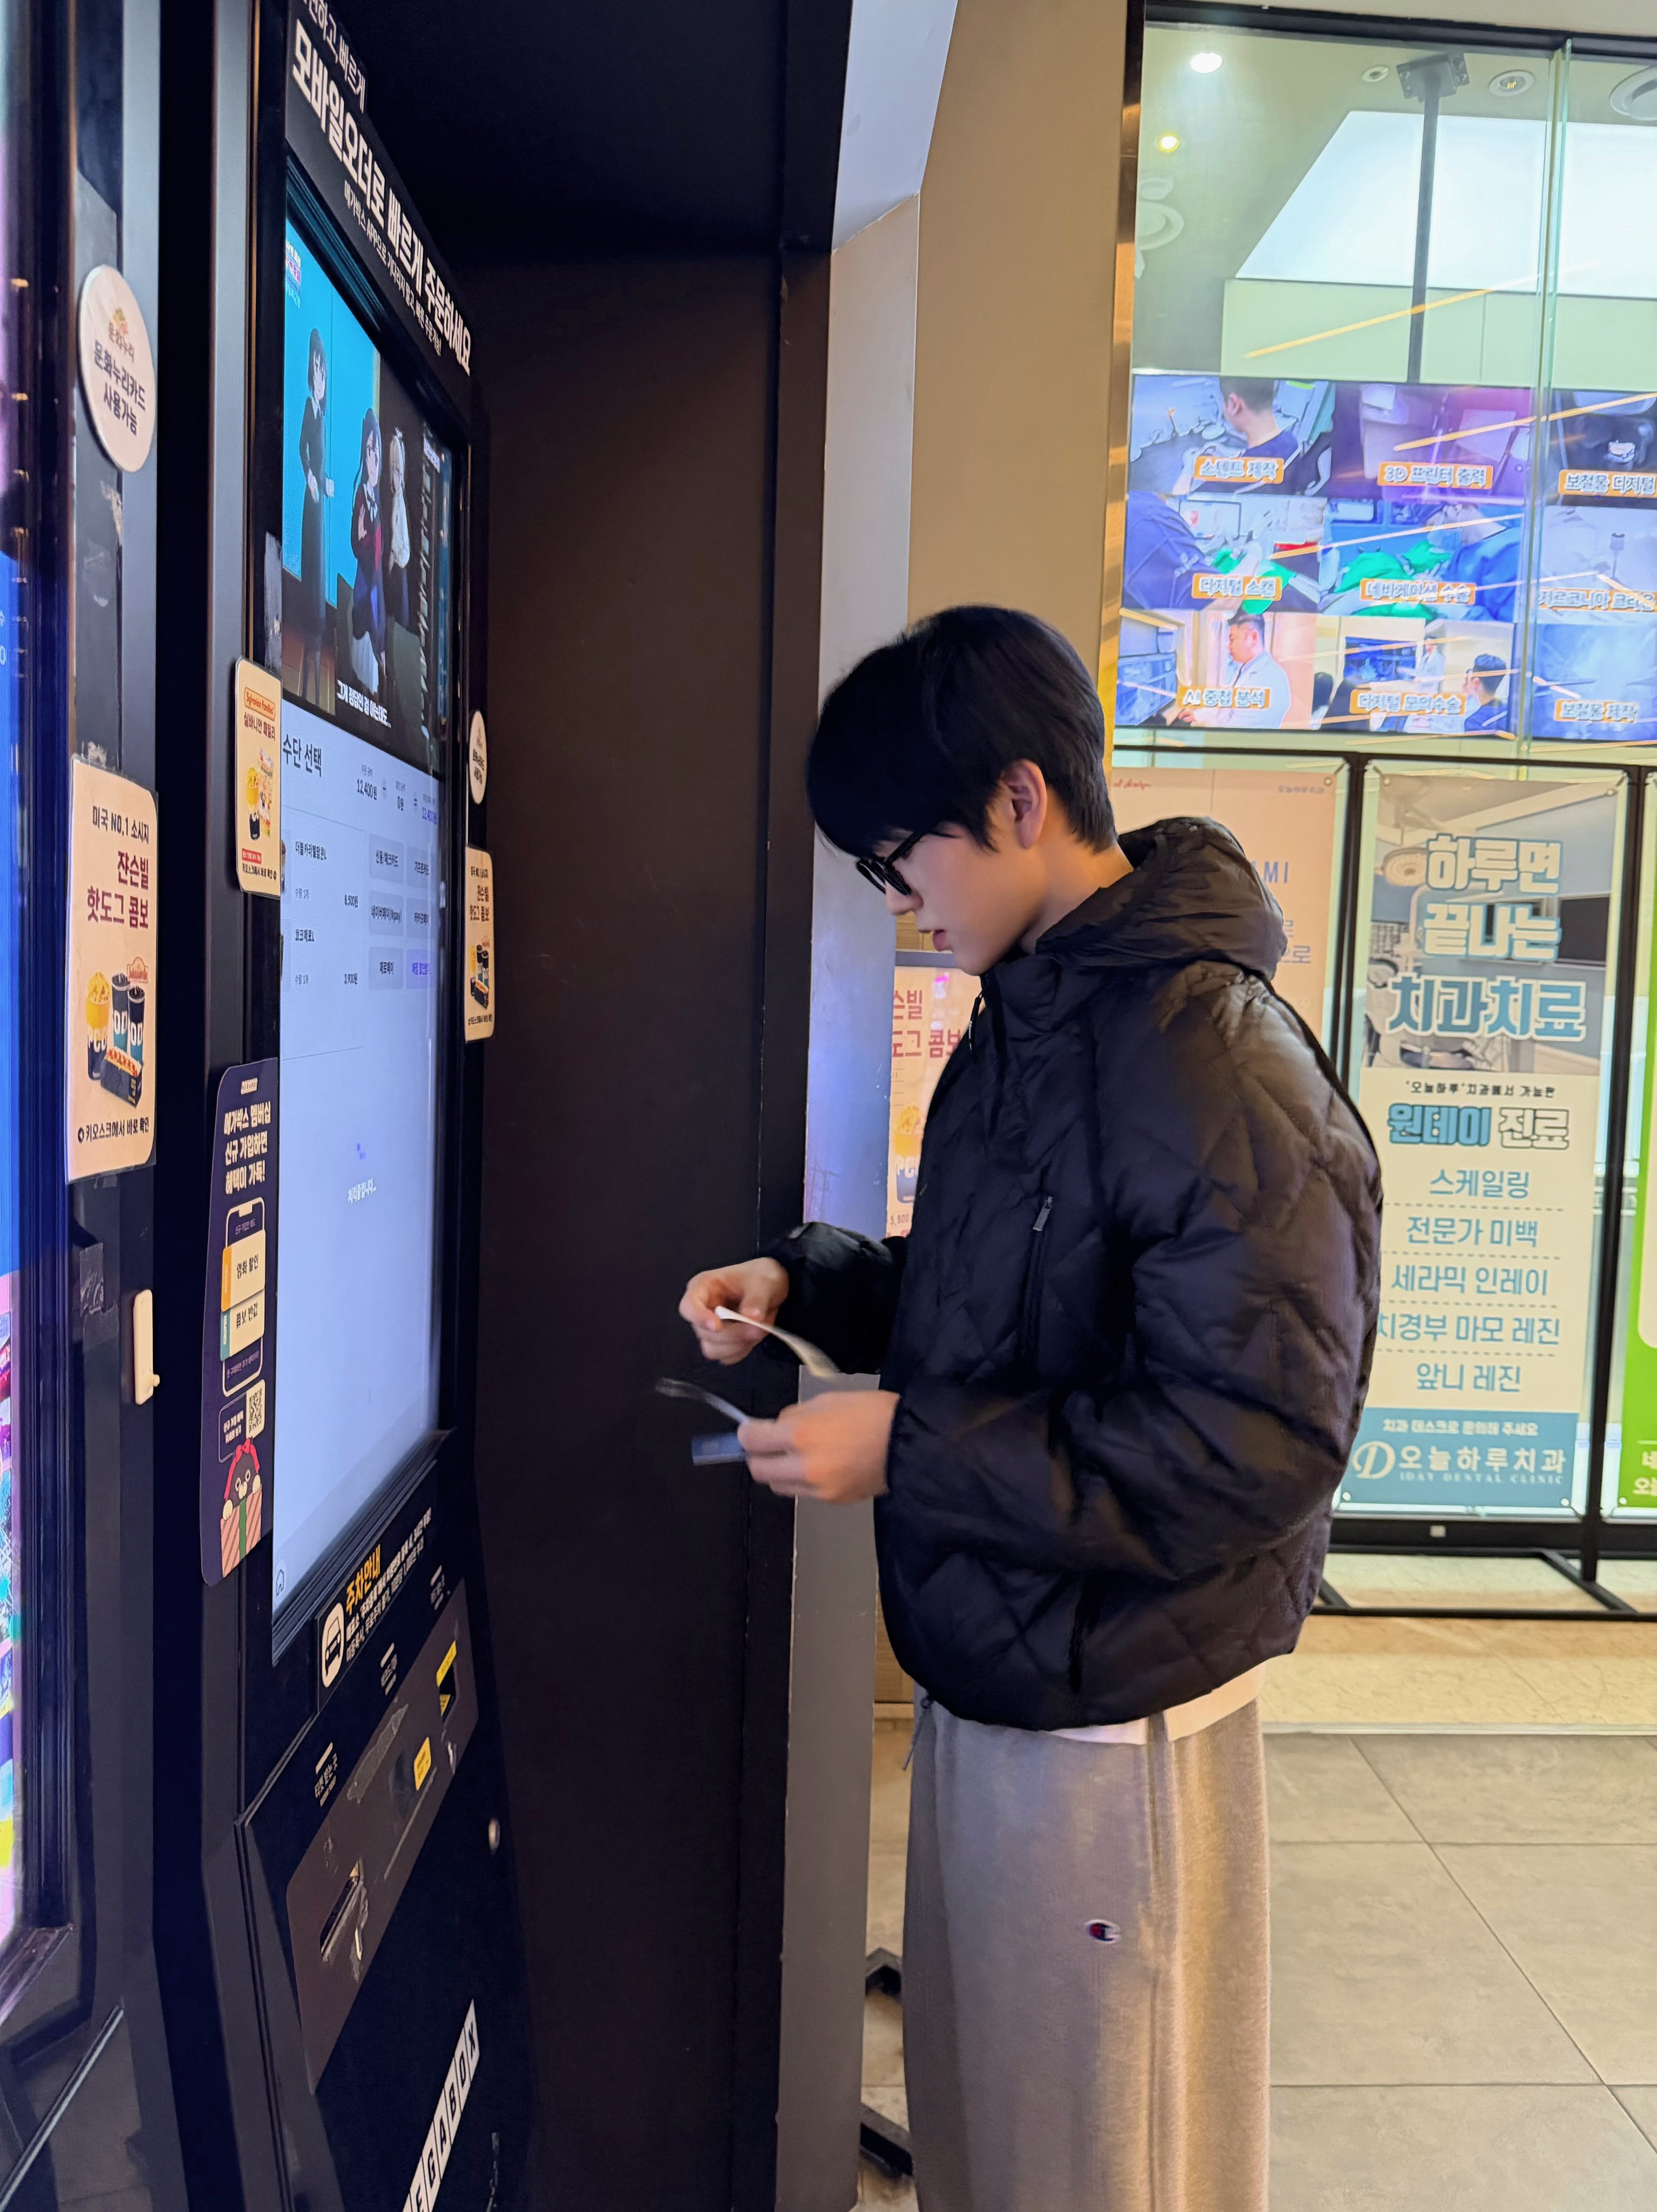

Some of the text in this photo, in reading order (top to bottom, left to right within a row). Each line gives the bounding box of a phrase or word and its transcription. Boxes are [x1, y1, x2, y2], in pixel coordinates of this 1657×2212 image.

[304, 0, 366, 114] 하고, 빠르게
[293, 18, 471, 377] 모바일오더로 빠르게 주문하세요
[344, 179, 366, 231] 메가박스
[367, 217, 387, 268] APP으로
[387, 250, 406, 298] 기다리지
[109, 322, 135, 364] 문화누리
[93, 339, 146, 412] 문화누리카드
[103, 381, 137, 436] 사용가능
[1384, 465, 1486, 486] 3D 프린터 출력
[1565, 473, 1656, 496] 보철물 디지털
[1199, 577, 1276, 597] 디지털 스캔
[1366, 581, 1472, 603] 네비게이션 수술
[1539, 588, 1610, 608] 지르코니아
[246, 689, 262, 710] Sylvanian
[337, 679, 348, 703] 그게
[349, 685, 364, 712] 정답인
[1235, 690, 1265, 709] 분석
[1359, 692, 1400, 712] 디지털
[243, 712, 276, 741] 실바니안 패밀리
[1561, 702, 1603, 721] 보철물
[283, 734, 322, 777] 수단 선택
[357, 778, 378, 801] 12,400원
[397, 796, 404, 811] 0원
[92, 805, 149, 844] 미국 NO.1 소시지
[117, 850, 149, 890] 쟌슨빌
[376, 849, 398, 867] 신용/체크카드
[1425, 833, 1563, 894] 하루면
[87, 885, 149, 929] 핫도그 콤보
[371, 904, 402, 924] 네이버페이(Npay)
[1424, 902, 1562, 962] 끝나는
[344, 974, 358, 985] 3,900원
[1384, 975, 1587, 1042] 치과치료
[928, 1029, 961, 1058] 콤보
[85, 1115, 149, 1143] 키오스크에서 바로 확인
[223, 1101, 271, 1137] 메가박스 멤버십
[1387, 1102, 1570, 1150] 원데이 진료
[225, 1130, 268, 1165] 신규 가입하면
[225, 1160, 266, 1195] 혜택이 가득!
[1428, 1169, 1530, 1199] 스케일링
[891, 1212, 910, 1227] 5,900
[1406, 1215, 1539, 1248] 전문가 미백
[236, 1260, 249, 1281] 영화
[249, 1254, 260, 1271] 할인
[1390, 1264, 1549, 1296] 세라믹 인레이
[235, 1302, 259, 1330] 콤보 반값
[1455, 1315, 1505, 1344] 마모
[1512, 1317, 1560, 1346] 레진
[1417, 1362, 1522, 1393] 앞니 레진
[1382, 1418, 1539, 1437] 치과 데스크로 문의해 주세요
[1399, 1445, 1566, 1474] 오늘하루치과
[1509, 1474, 1564, 1485] CLINIC
[345, 1544, 381, 1614] 주차안내
